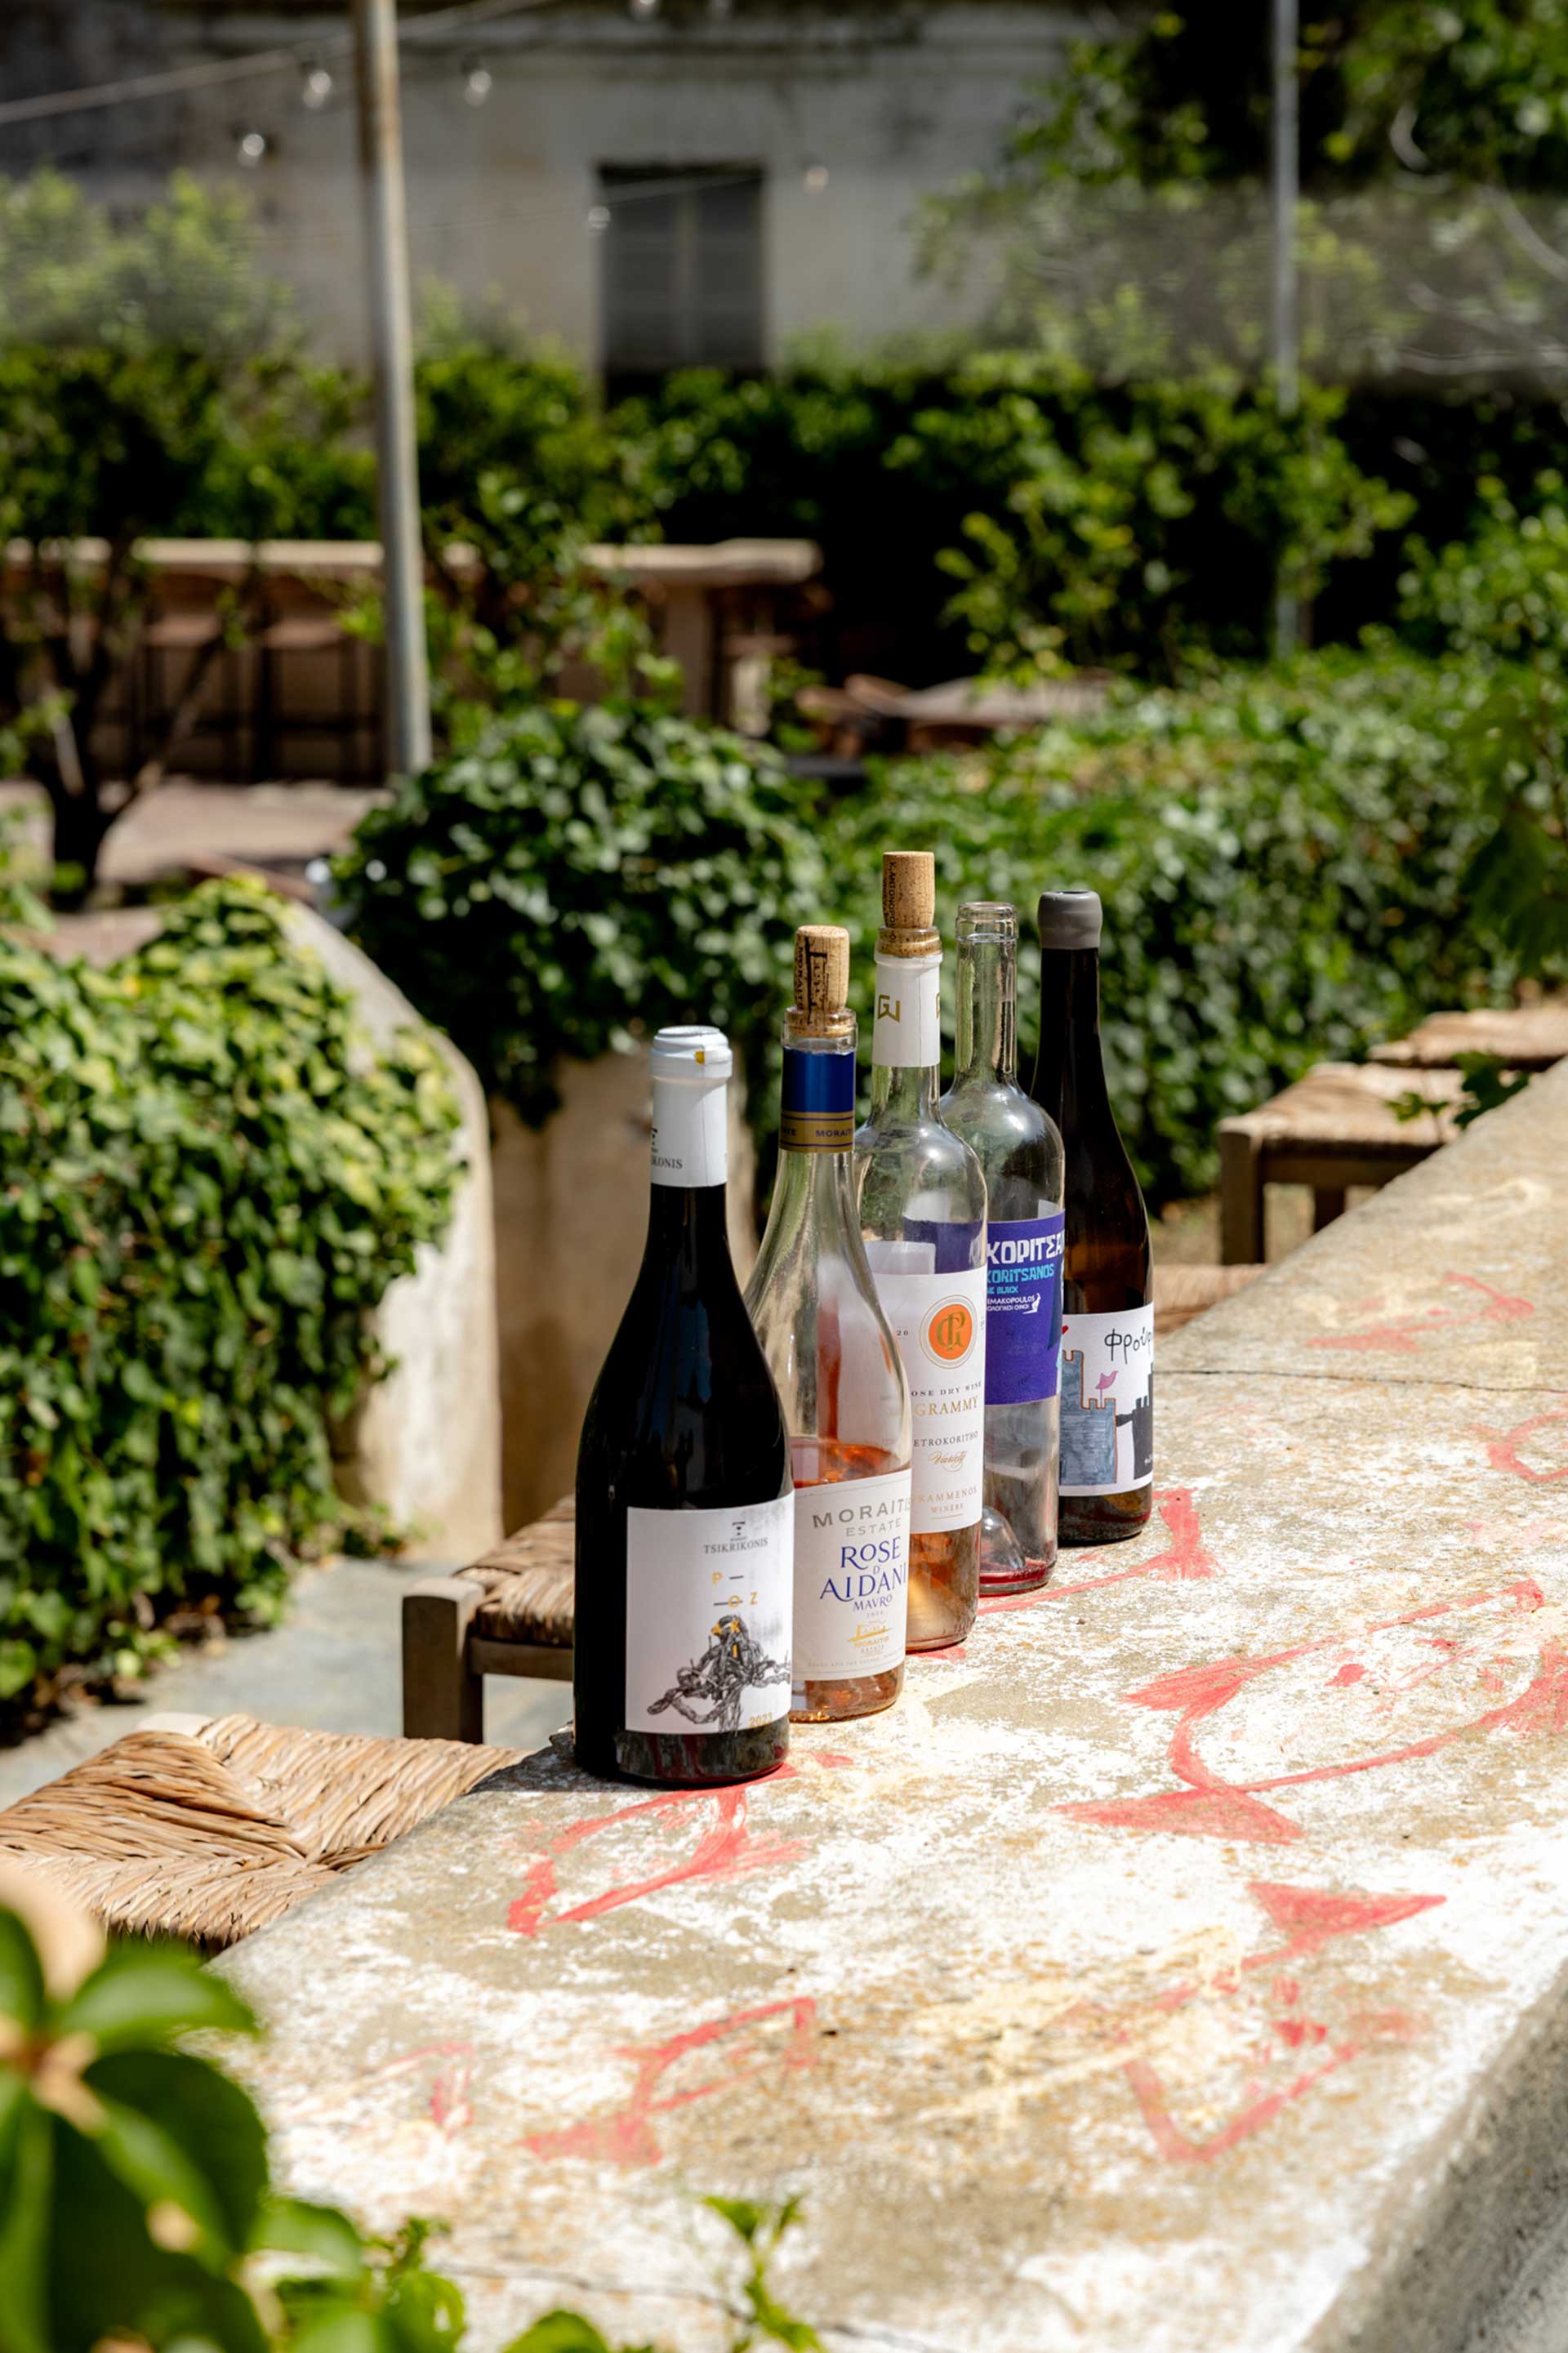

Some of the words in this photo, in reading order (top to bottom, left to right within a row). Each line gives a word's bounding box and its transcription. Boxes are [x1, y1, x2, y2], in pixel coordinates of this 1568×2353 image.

[913, 1431, 978, 1447] ETROKORITHO
[845, 1517, 901, 1536] ESTATE
[704, 1537, 768, 1554] TSIKRIKONIS
[840, 1536, 901, 1570] ROSE
[819, 1562, 906, 1602] AIDANI
[853, 1593, 893, 1611] MAVRO
